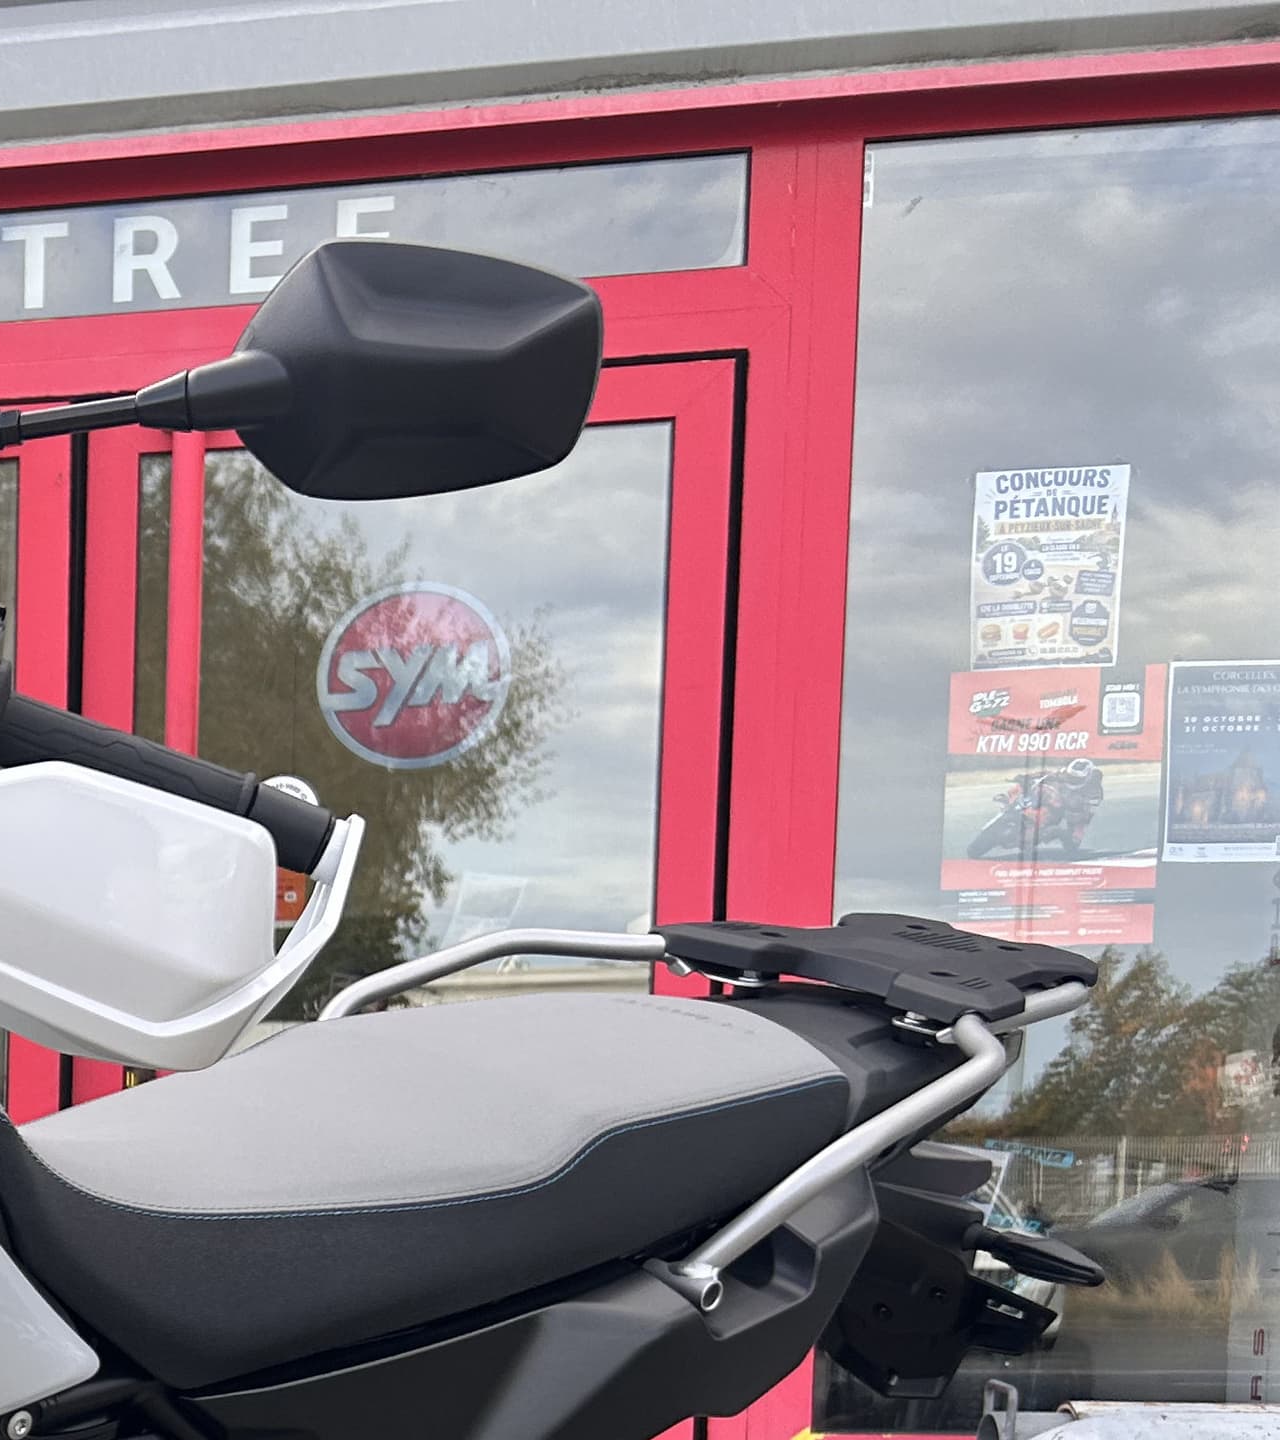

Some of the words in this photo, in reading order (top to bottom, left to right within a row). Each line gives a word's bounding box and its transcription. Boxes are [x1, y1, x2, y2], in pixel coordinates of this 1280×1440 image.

[995, 468, 1111, 494] CONCOURS
[1046, 488, 1058, 497] DE
[994, 494, 1110, 520] PÉTANQUE
[992, 551, 1018, 573] 19
[328, 640, 497, 728] SYM
[1202, 725, 1260, 733] OCTOBRE
[1203, 714, 1261, 723] OCTOBRE
[976, 733, 1014, 752] KTM
[1017, 732, 1051, 752] 990
[1054, 731, 1089, 750] RCR
